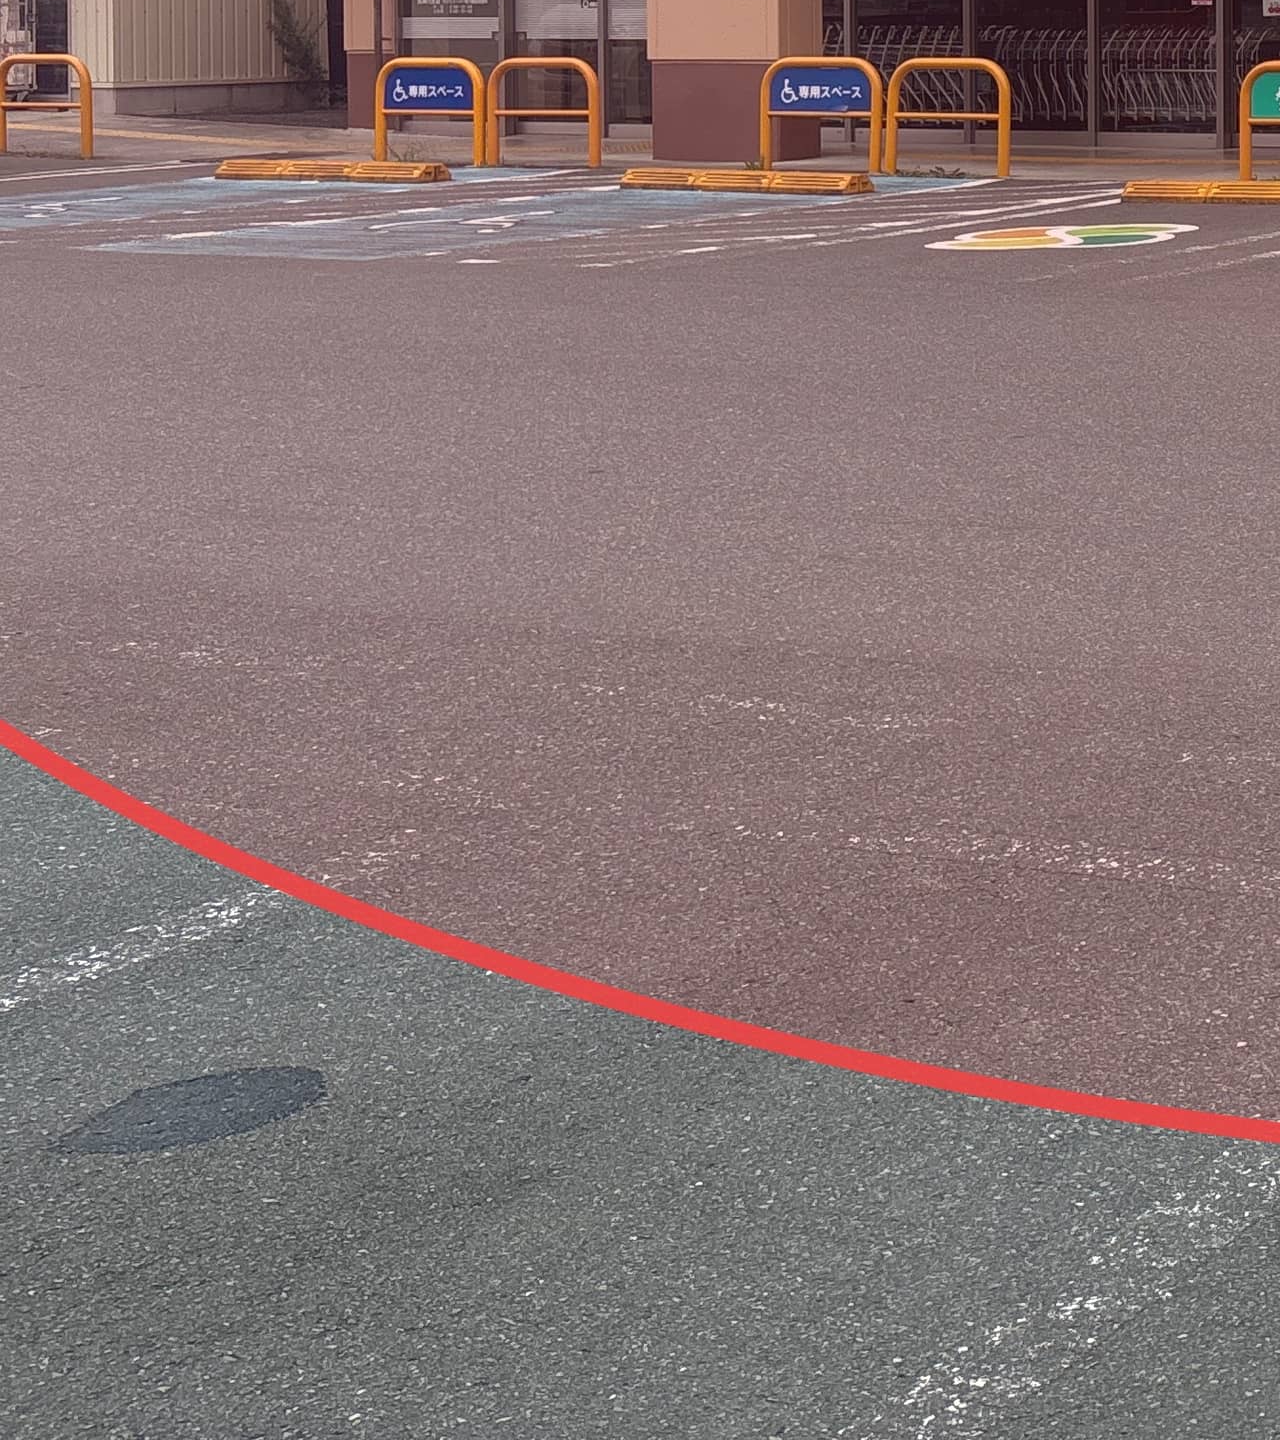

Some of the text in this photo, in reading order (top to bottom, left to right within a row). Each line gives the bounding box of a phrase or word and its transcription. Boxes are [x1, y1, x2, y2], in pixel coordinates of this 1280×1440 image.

[408, 85, 464, 98] 専用スペース
[798, 85, 862, 99] 専用スペース
